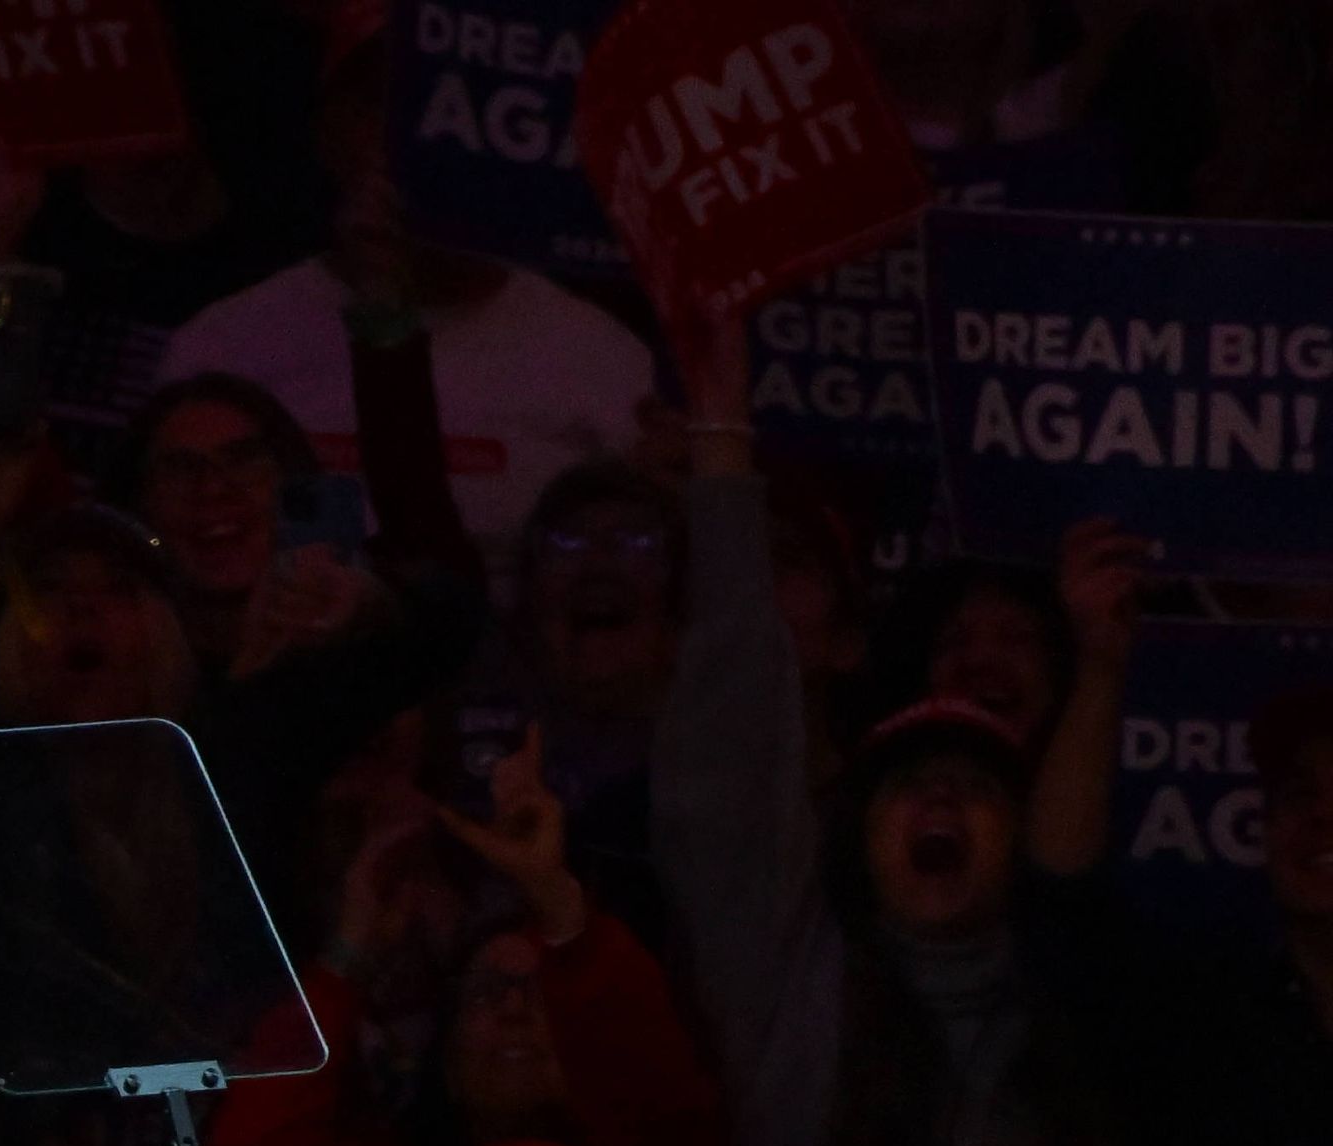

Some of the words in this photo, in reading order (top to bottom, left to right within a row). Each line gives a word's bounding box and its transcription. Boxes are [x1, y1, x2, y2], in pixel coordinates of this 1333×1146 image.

[74, 19, 132, 71] IT
[416, 6, 585, 82] DREA
[679, 131, 801, 228] FIX
[801, 102, 864, 166] IT
[954, 308, 1187, 375] DREAM
[1207, 322, 1333, 380] BIG
[971, 377, 1319, 473] AGAIN!
